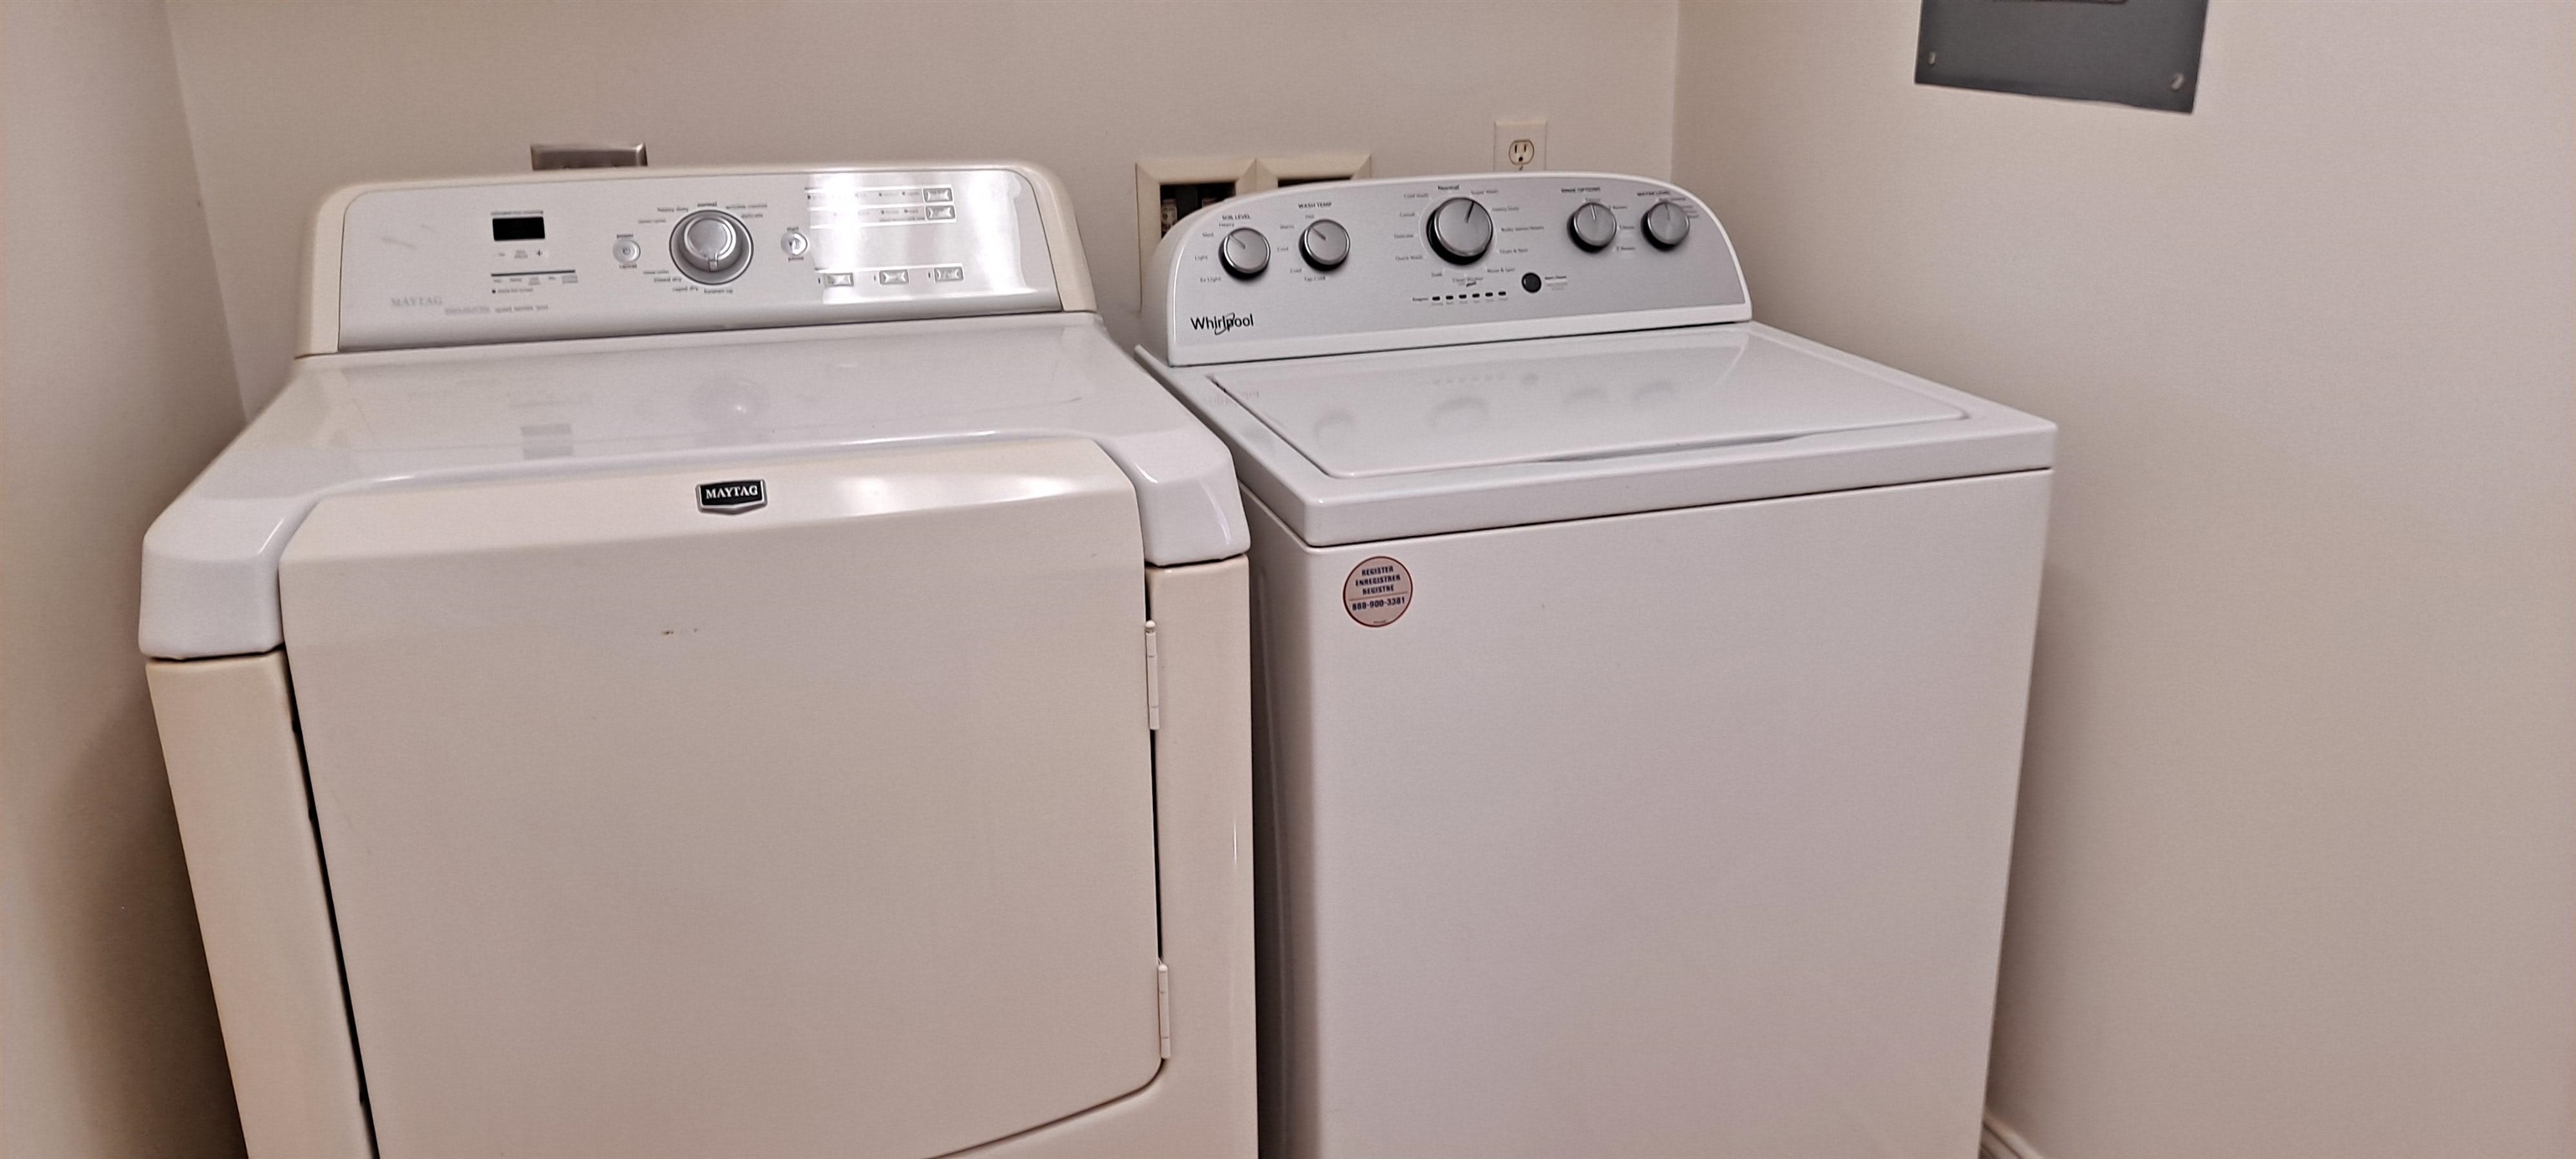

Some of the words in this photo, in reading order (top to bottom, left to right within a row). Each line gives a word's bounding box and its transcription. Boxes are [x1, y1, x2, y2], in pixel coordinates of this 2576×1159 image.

[390, 296, 443, 307] MAYTAG
[1190, 312, 1254, 335] Whirlpool
[705, 485, 758, 499] MAYTAG
[1361, 565, 1394, 577] REGISTER
[1355, 574, 1401, 587] ENREGISTRER
[1362, 585, 1394, 595] REGISTRE
